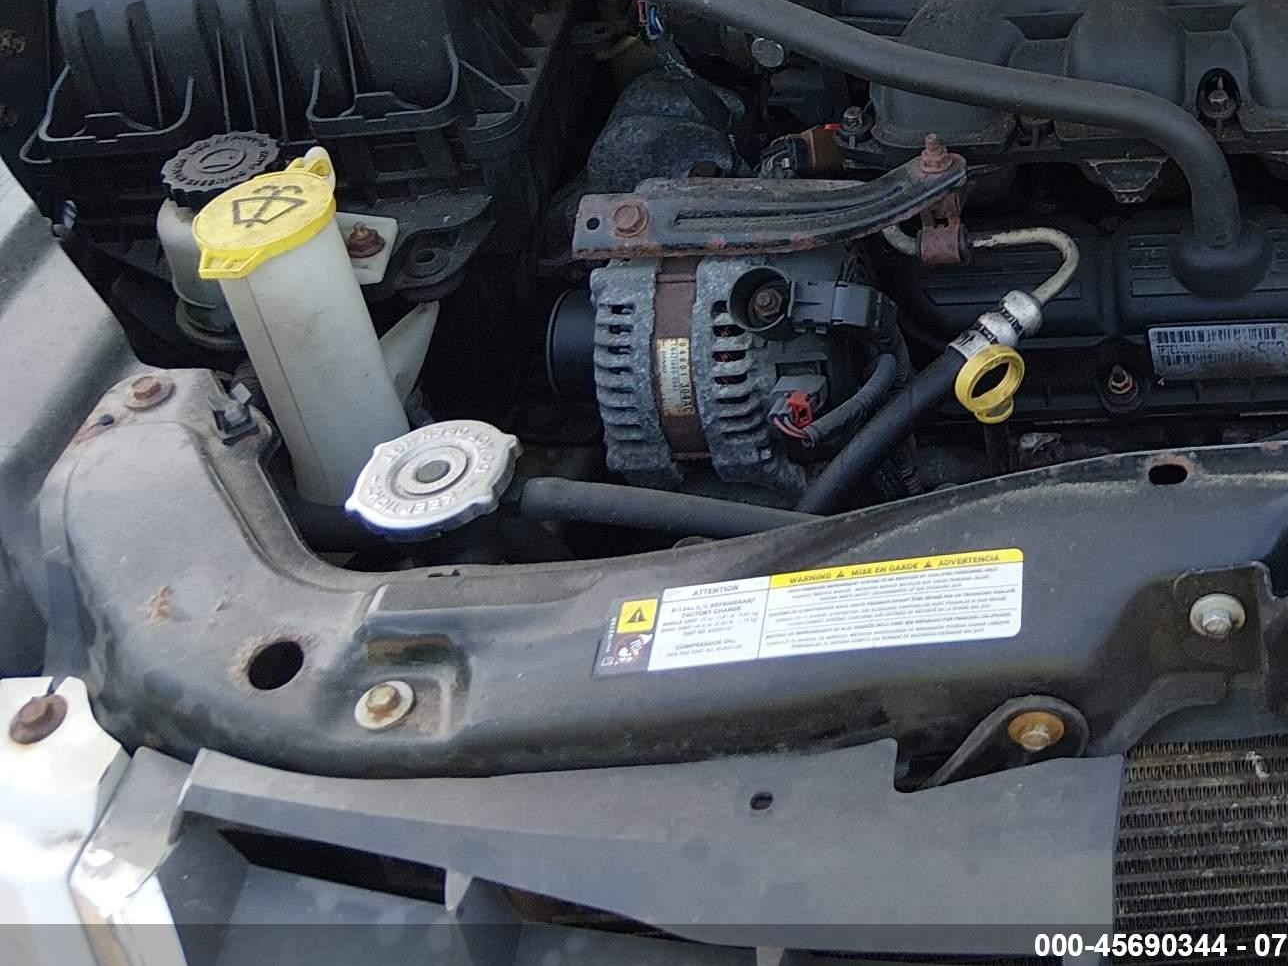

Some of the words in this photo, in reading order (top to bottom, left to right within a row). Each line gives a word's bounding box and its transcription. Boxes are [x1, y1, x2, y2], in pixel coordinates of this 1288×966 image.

[789, 572, 832, 584] WARNING
[851, 566, 874, 577] MISE
[874, 564, 888, 574] EN
[889, 561, 919, 572] GARDE
[938, 554, 1001, 567] ADVERTENCIA
[692, 584, 741, 596] ATTENTION
